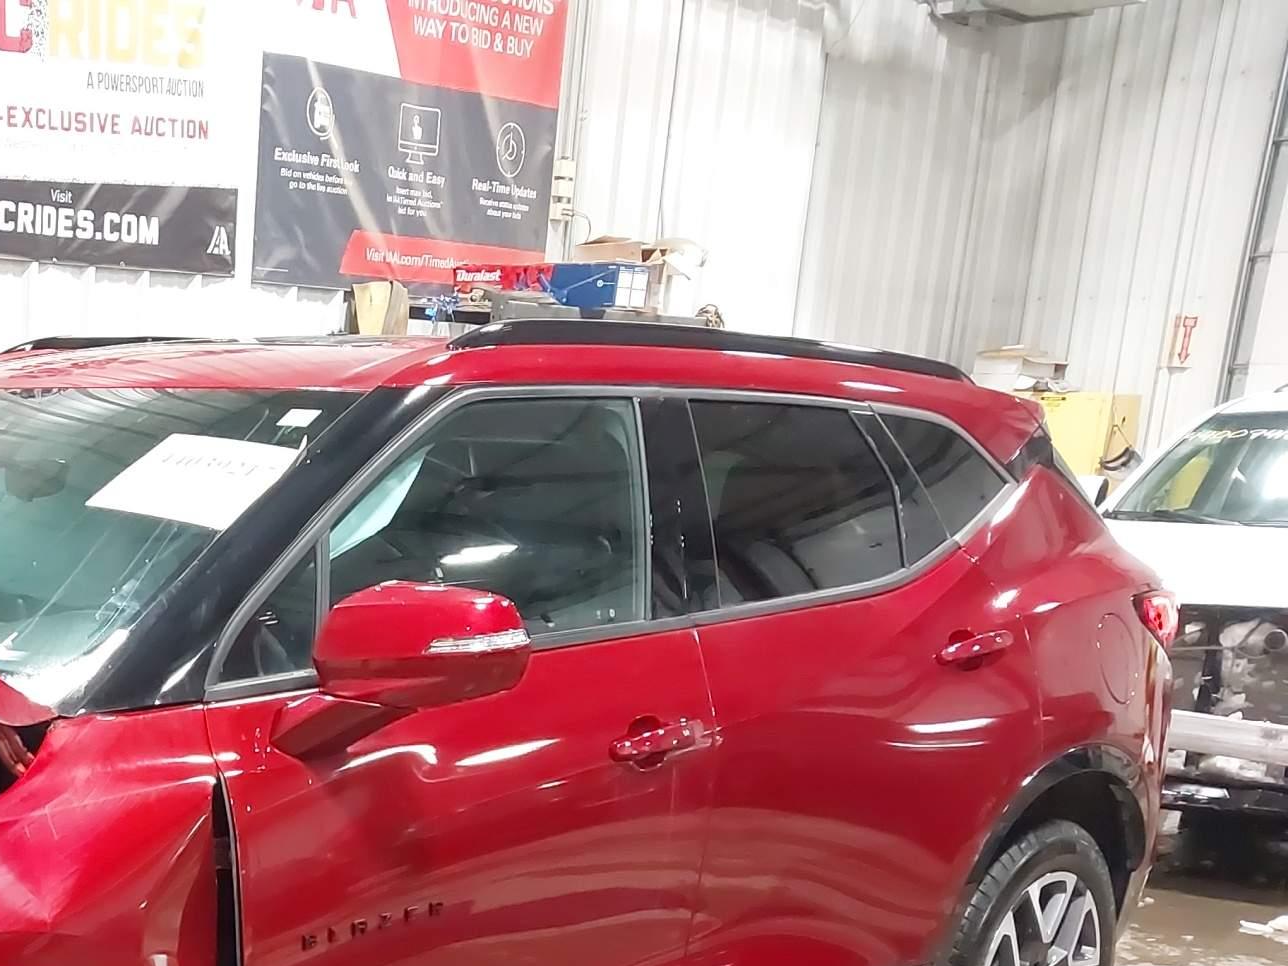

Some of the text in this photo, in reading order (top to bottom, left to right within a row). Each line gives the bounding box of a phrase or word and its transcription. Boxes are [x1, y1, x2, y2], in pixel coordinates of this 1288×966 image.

[501, 10, 511, 30] A
[513, 13, 544, 36] NEW
[413, 15, 534, 57] WAY TO BID & BUY
[86, 71, 205, 98] A POWERSPORT AUCTION
[130, 115, 209, 140] AUCTION
[274, 146, 320, 166] Exclusive
[320, 153, 341, 169] First
[280, 167, 292, 177] Bid
[293, 170, 302, 178] on
[303, 171, 324, 182] vehicles
[289, 180, 298, 190] go
[299, 181, 306, 189] to
[307, 181, 316, 190] the
[388, 165, 446, 188] Quick and Easy
[50, 188, 73, 204] Visit
[471, 178, 537, 199] Real-Time Updates
[366, 247, 469, 269] Visit IAAI.com/TimedA
[455, 268, 502, 282] Duralast
